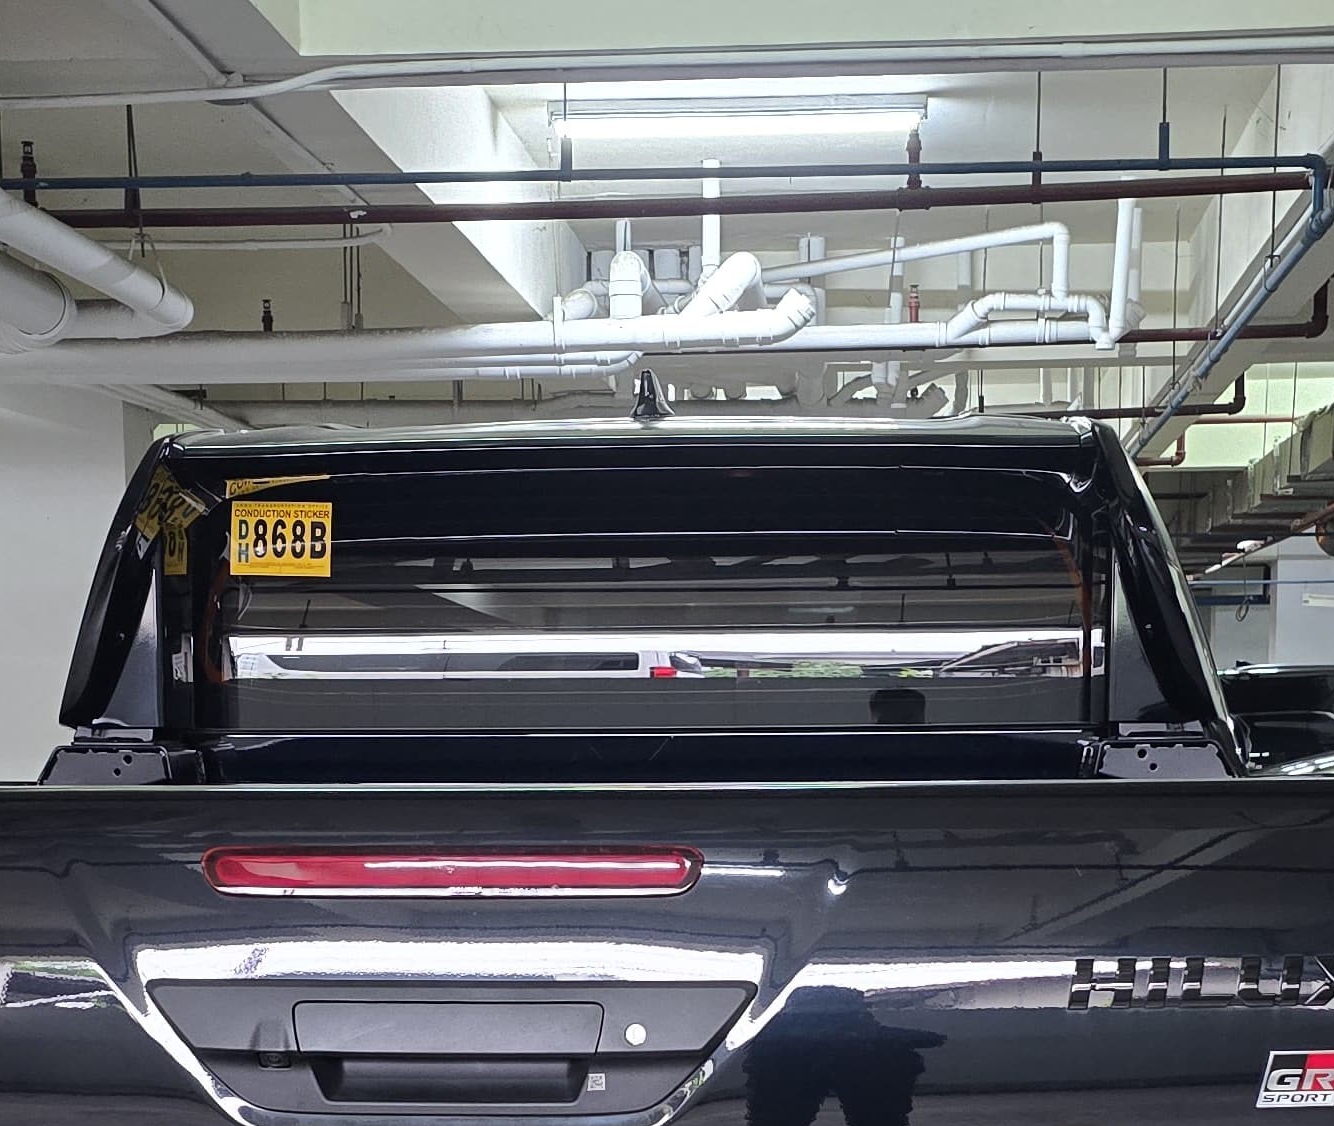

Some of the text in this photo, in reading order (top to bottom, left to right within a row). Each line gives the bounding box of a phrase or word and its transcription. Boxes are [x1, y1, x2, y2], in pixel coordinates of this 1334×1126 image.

[234, 508, 330, 519] CONDUCTION STICKER
[253, 518, 327, 559] 868B
[1261, 1093, 1332, 1103] SPORT
